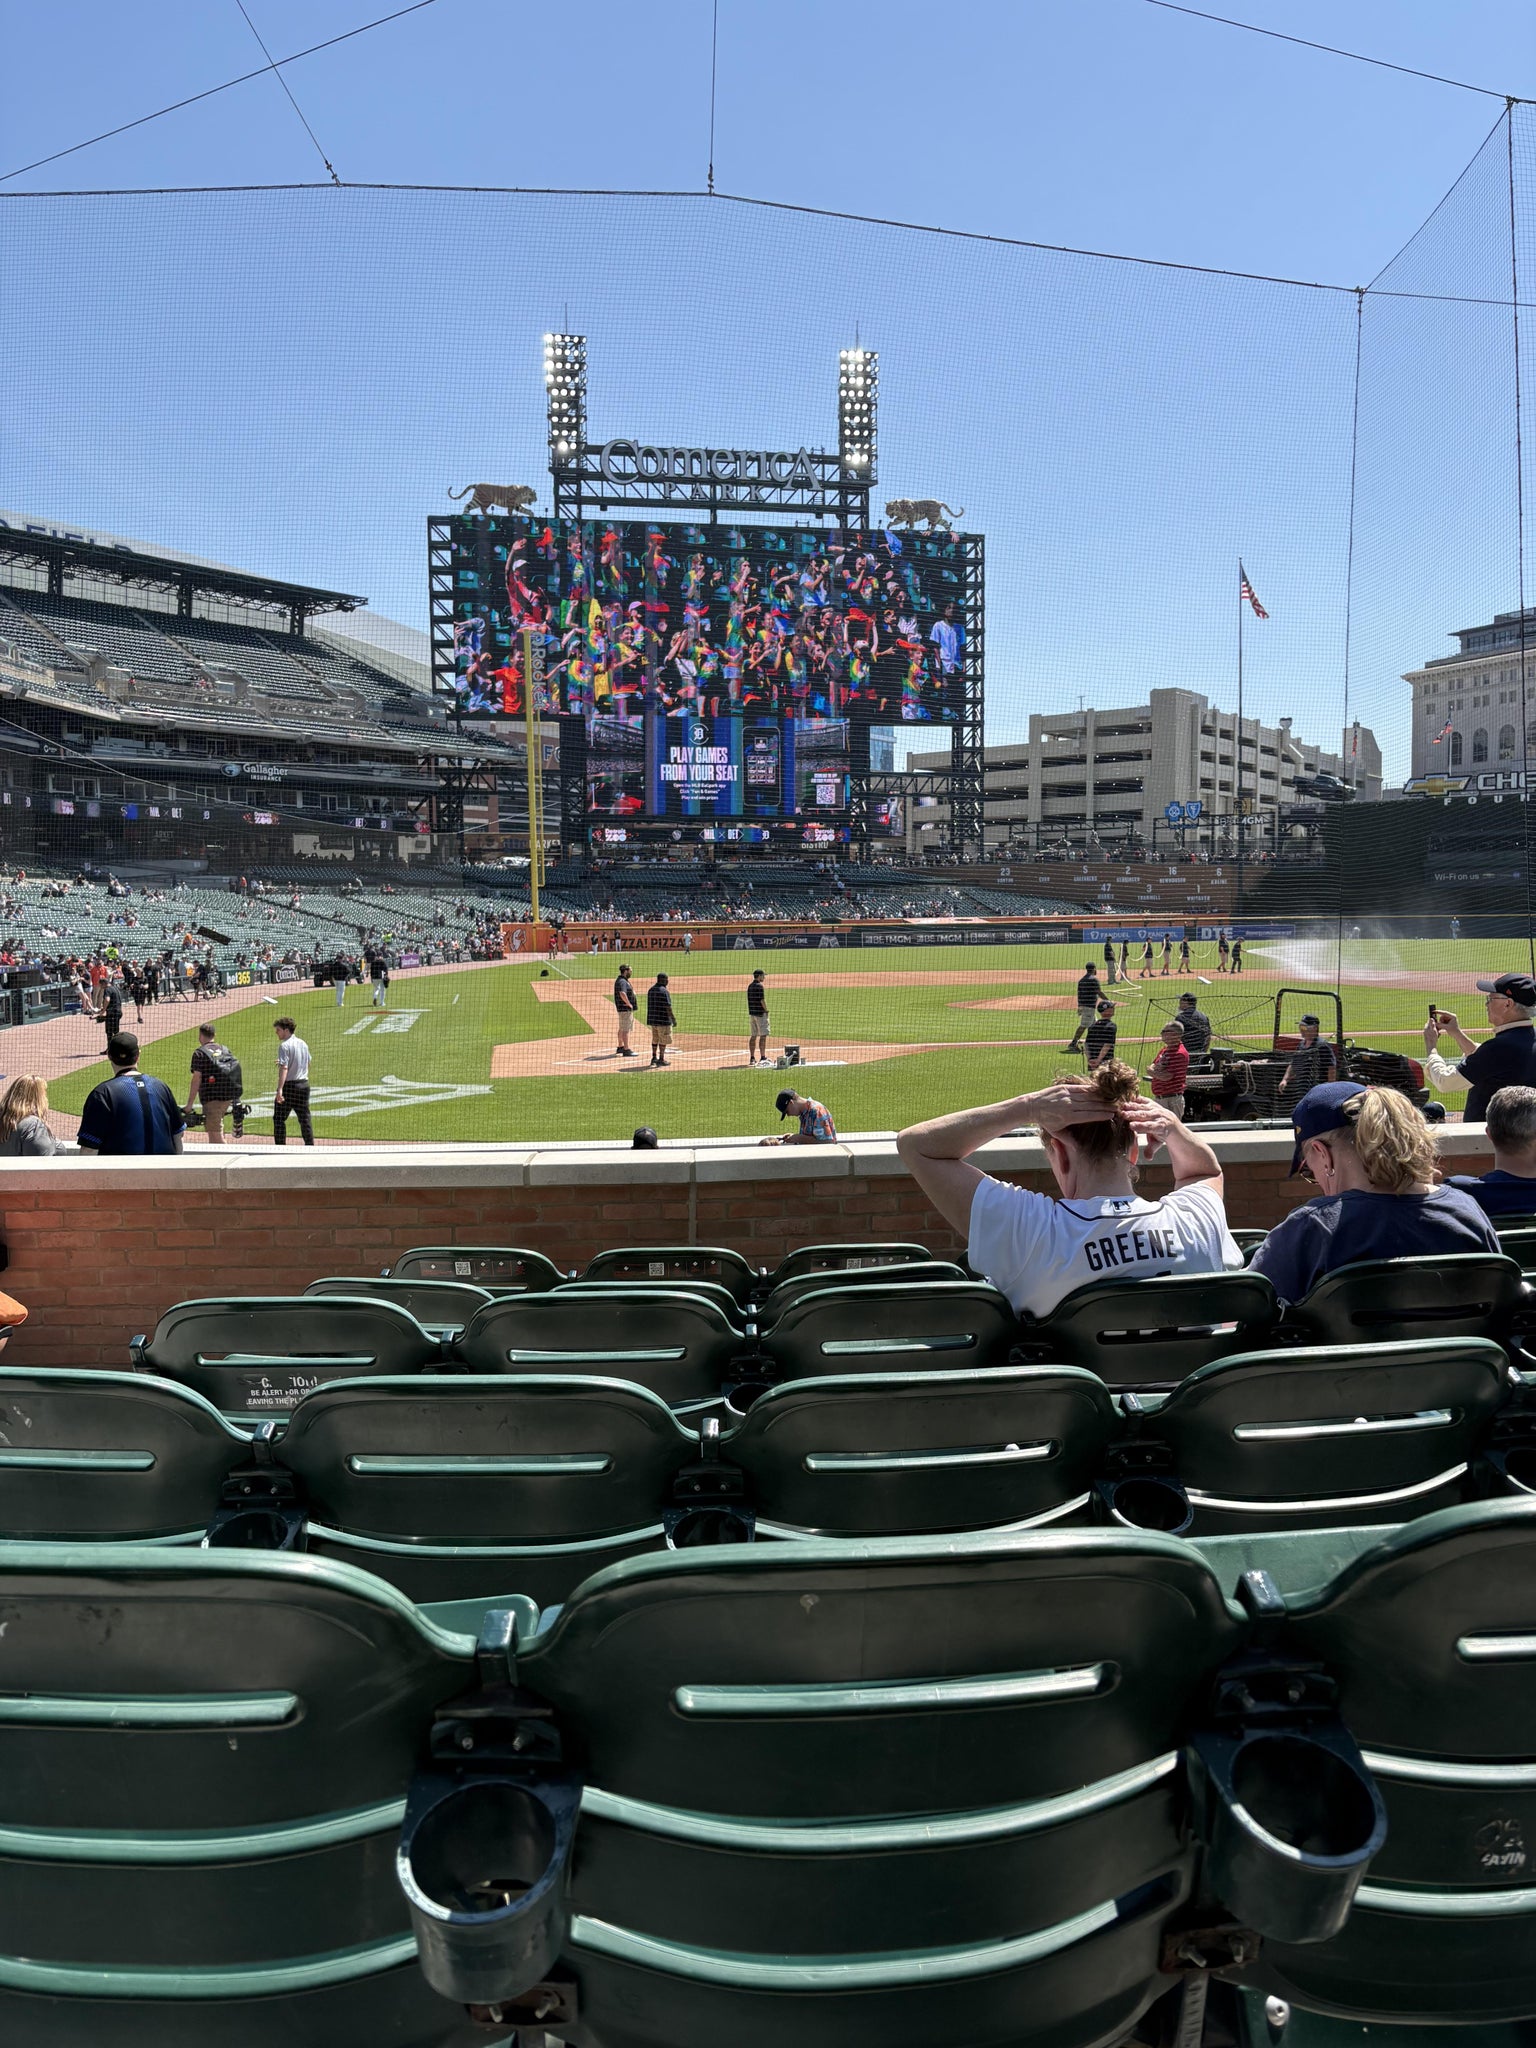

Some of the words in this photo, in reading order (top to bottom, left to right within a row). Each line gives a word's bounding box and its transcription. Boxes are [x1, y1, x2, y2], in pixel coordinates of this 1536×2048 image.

[664, 482, 766, 502] PARK
[670, 747, 694, 764] PLAY
[695, 747, 728, 764] GAMES
[243, 763, 289, 776] Gallagher
[660, 764, 687, 781] FROM
[688, 765, 714, 781] YOUR
[715, 765, 739, 781] SEAT
[250, 774, 281, 782] INSURANCE
[605, 834, 627, 842] ZOO
[727, 829, 739, 839] DET
[1000, 867, 1011, 877] 23
[1125, 866, 1131, 875] 2
[1168, 866, 1177, 875] 16
[1216, 868, 1222, 877] 6
[1434, 873, 1456, 881] Wi-Fi
[1100, 883, 1112, 892] 47
[1146, 884, 1152, 893] 3
[1201, 927, 1234, 940] DTE
[609, 939, 648, 949] PZZA!
[226, 971, 251, 985] bet365
[1083, 1229, 1178, 1272] GREENE
[250, 1389, 260, 1397] BE
